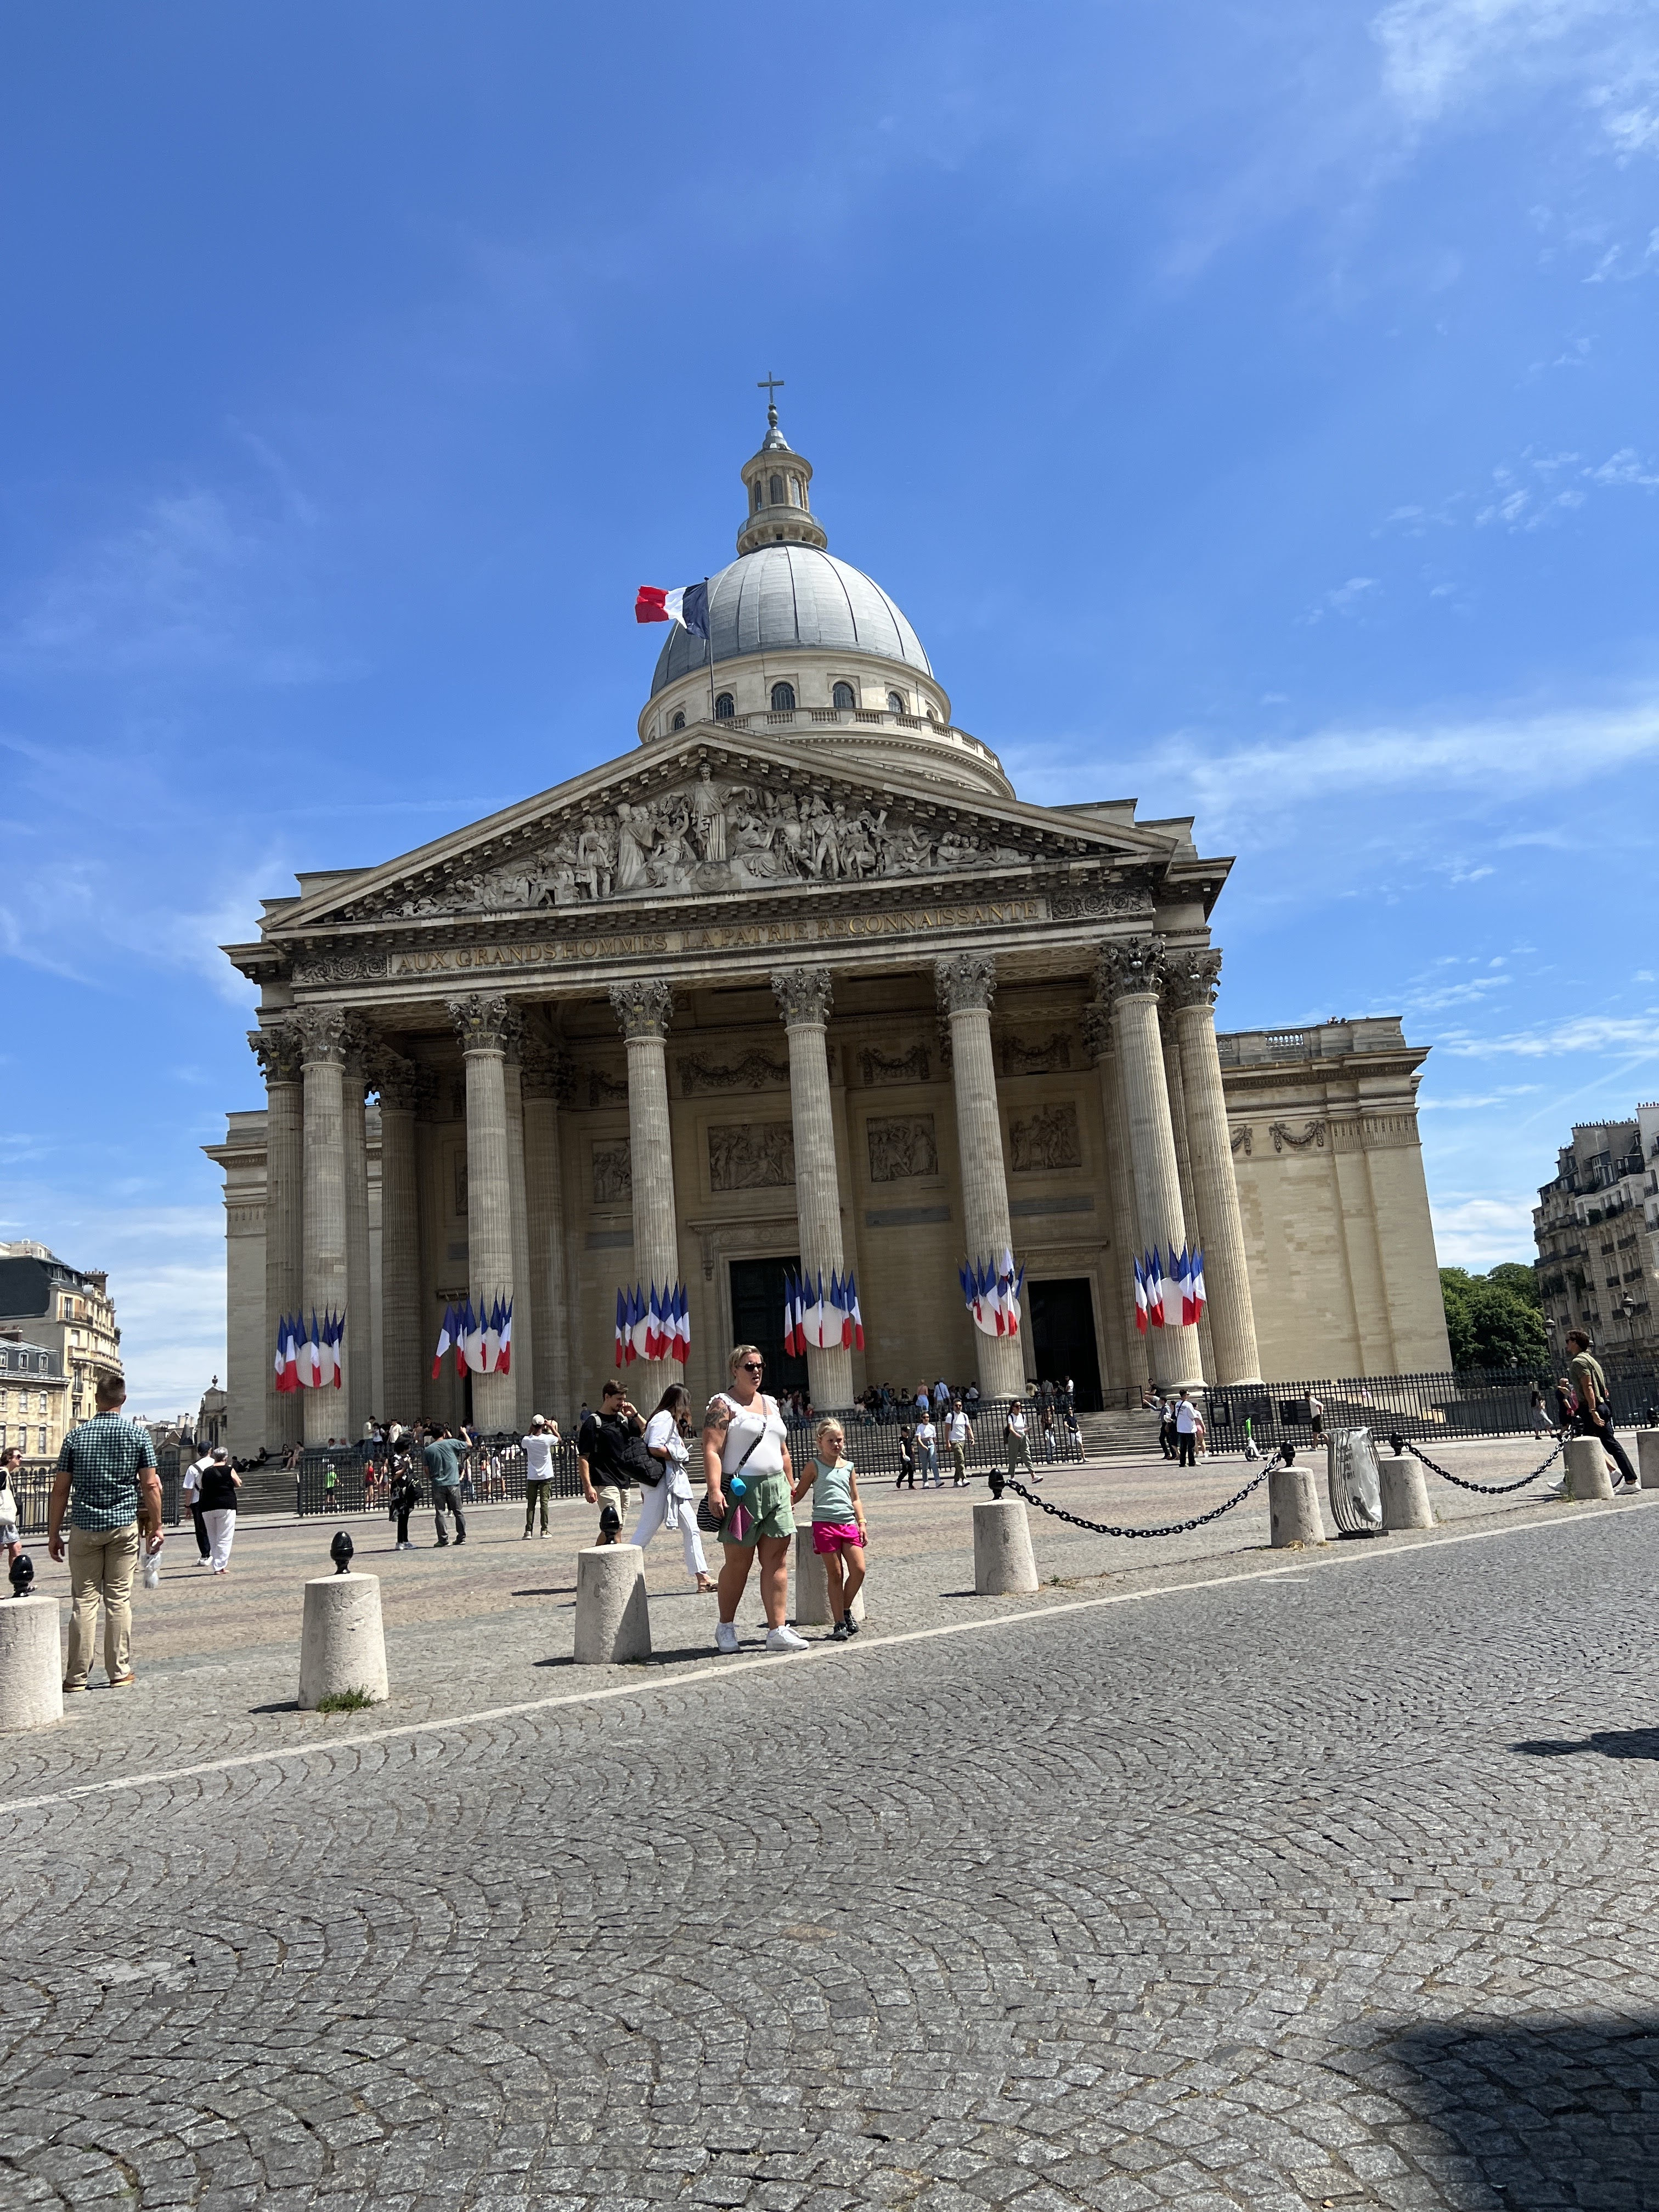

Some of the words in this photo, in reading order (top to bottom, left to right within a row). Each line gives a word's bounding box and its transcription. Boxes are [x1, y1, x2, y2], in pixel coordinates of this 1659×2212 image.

[398, 952, 449, 972] AUX
[456, 943, 557, 967] GRANDS
[561, 935, 668, 958] HOMMES
[681, 929, 714, 949] LA
[721, 921, 809, 945] PATRIE
[817, 901, 1039, 937] RECONNAISSANTE
